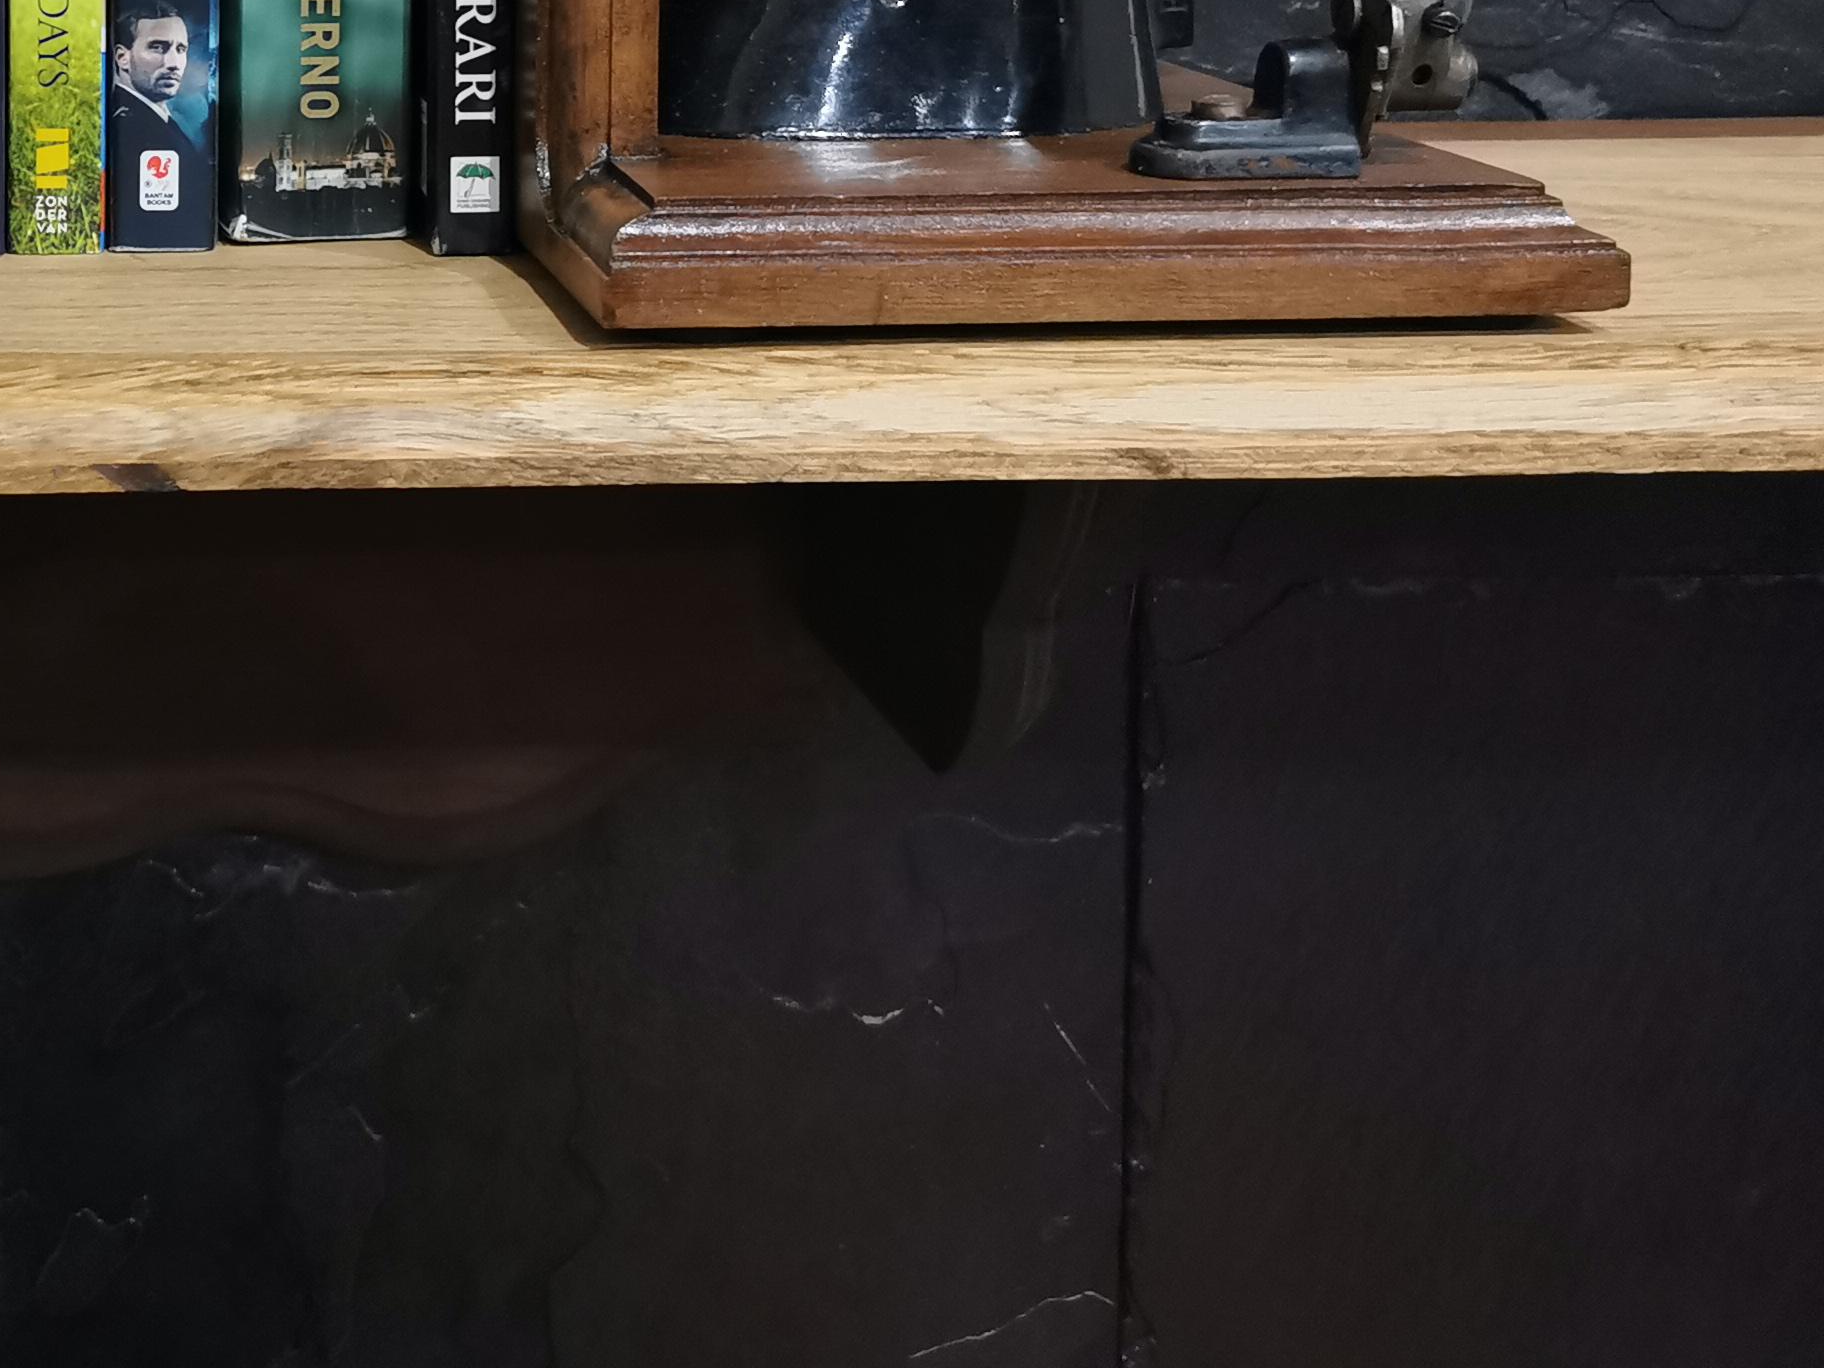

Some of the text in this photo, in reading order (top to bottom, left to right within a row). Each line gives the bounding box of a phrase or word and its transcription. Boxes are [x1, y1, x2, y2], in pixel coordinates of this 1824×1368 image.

[35, 195, 68, 208] ZON
[35, 209, 68, 221] DER
[36, 222, 68, 234] VAN
